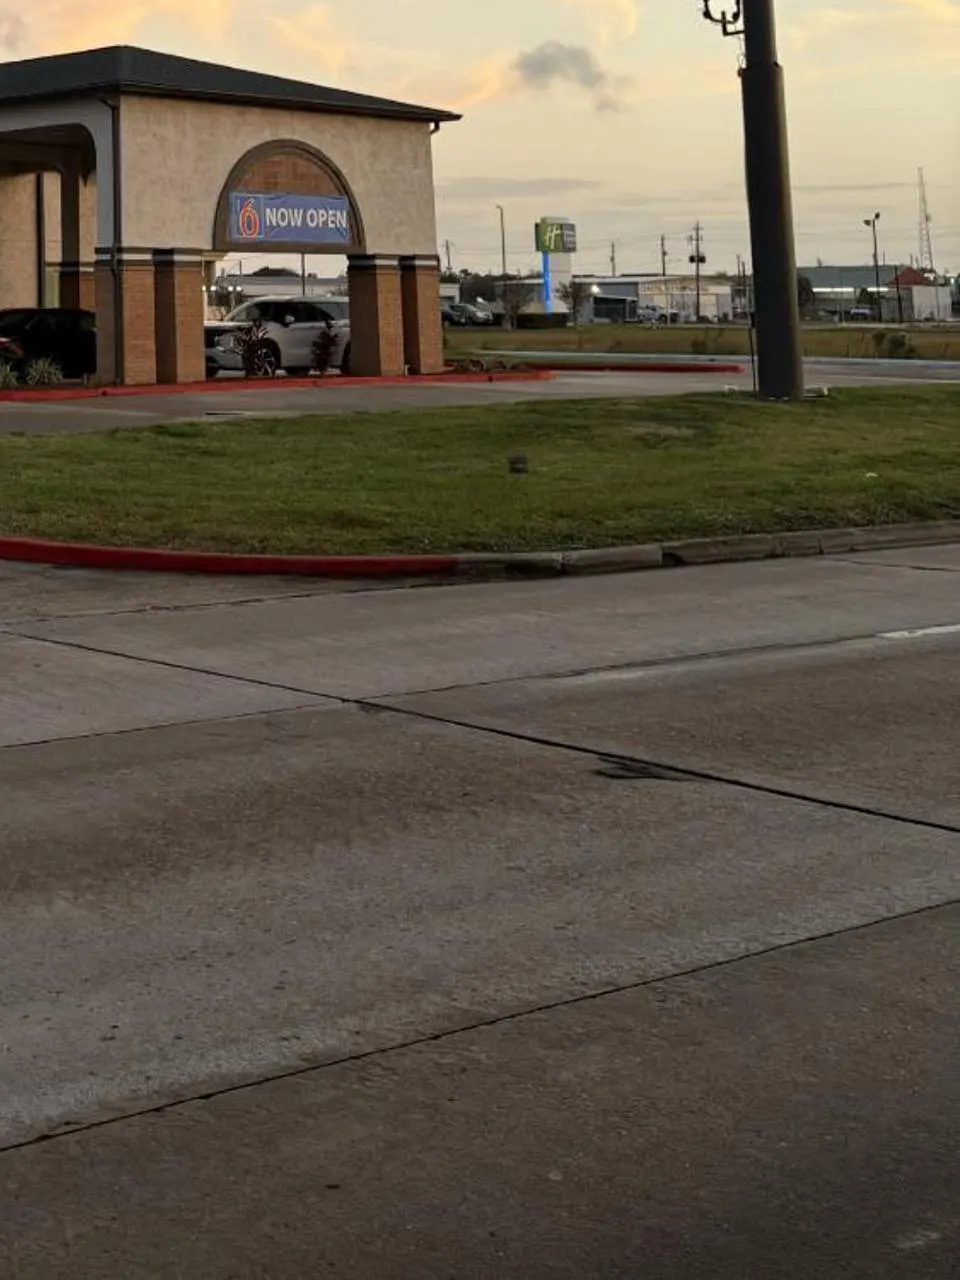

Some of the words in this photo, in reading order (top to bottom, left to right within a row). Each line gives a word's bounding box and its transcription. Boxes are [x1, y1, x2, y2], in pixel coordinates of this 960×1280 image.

[240, 198, 260, 238] 6
[265, 207, 303, 228] NOW
[305, 208, 347, 230] OPEN
